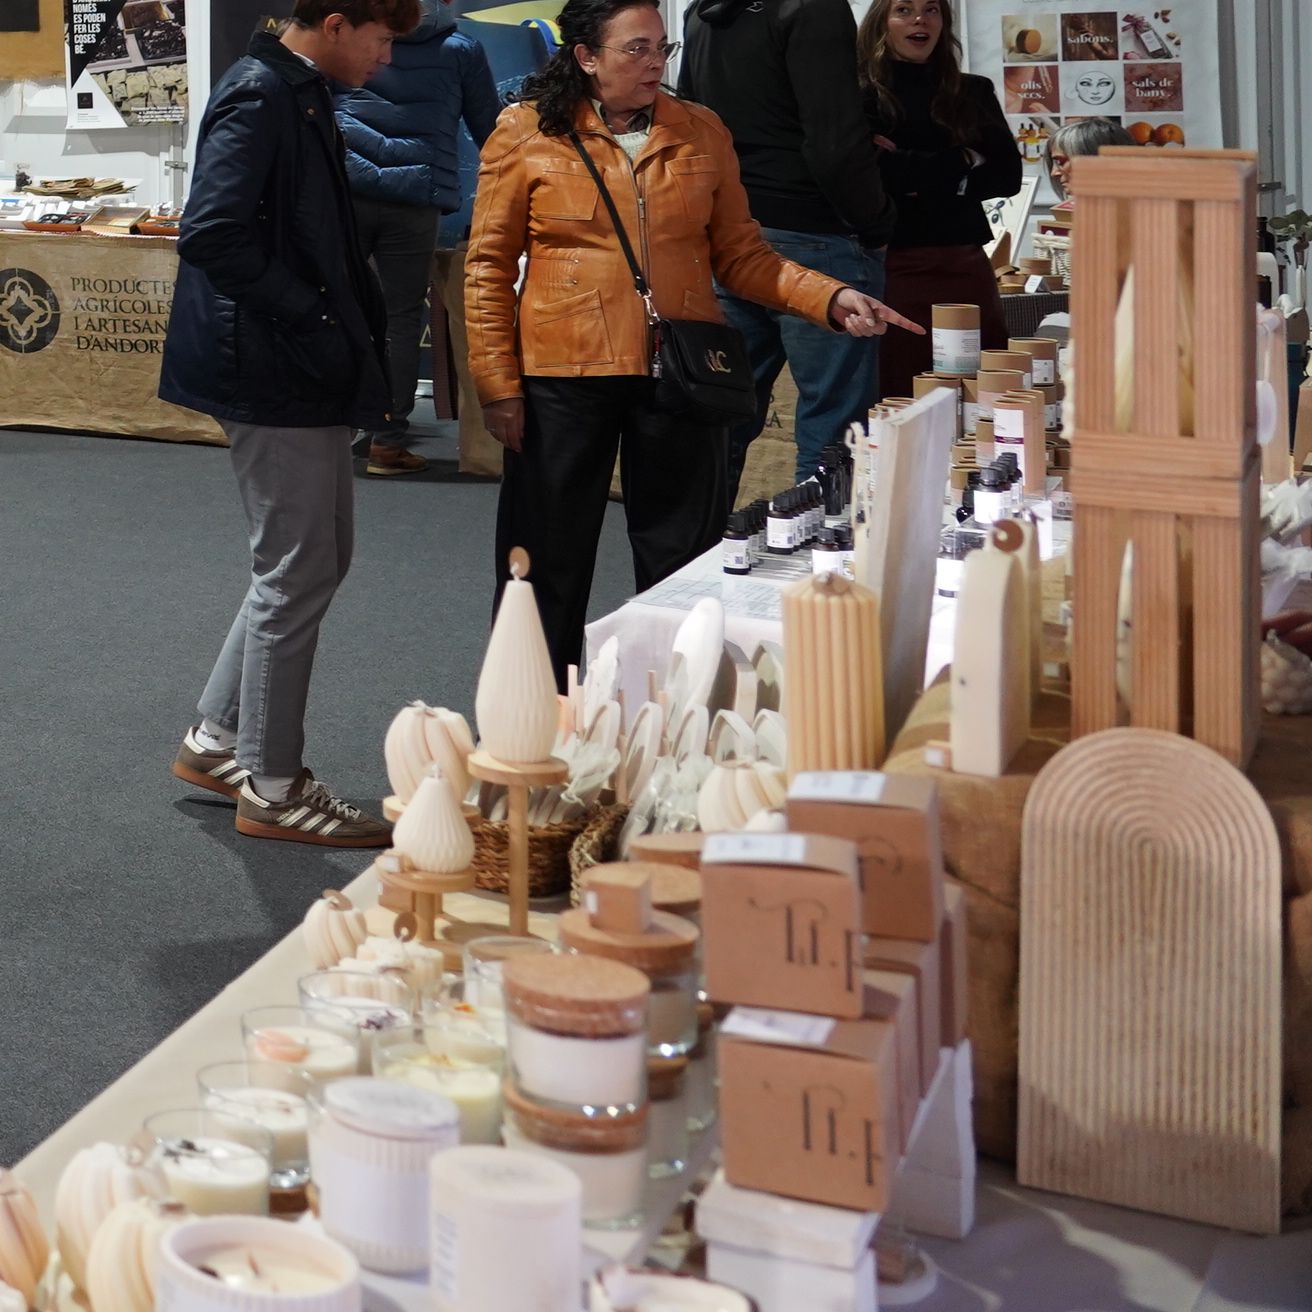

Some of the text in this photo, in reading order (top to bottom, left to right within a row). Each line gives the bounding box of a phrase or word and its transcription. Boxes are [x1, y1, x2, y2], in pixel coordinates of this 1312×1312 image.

[73, 13, 106, 23] ES PODEN
[74, 23, 101, 34] FER LES
[74, 34, 96, 44] COSES
[1067, 33, 1114, 44] sabons.
[84, 317, 169, 334] ARTESAN
[76, 335, 165, 354] D'ANDOR
